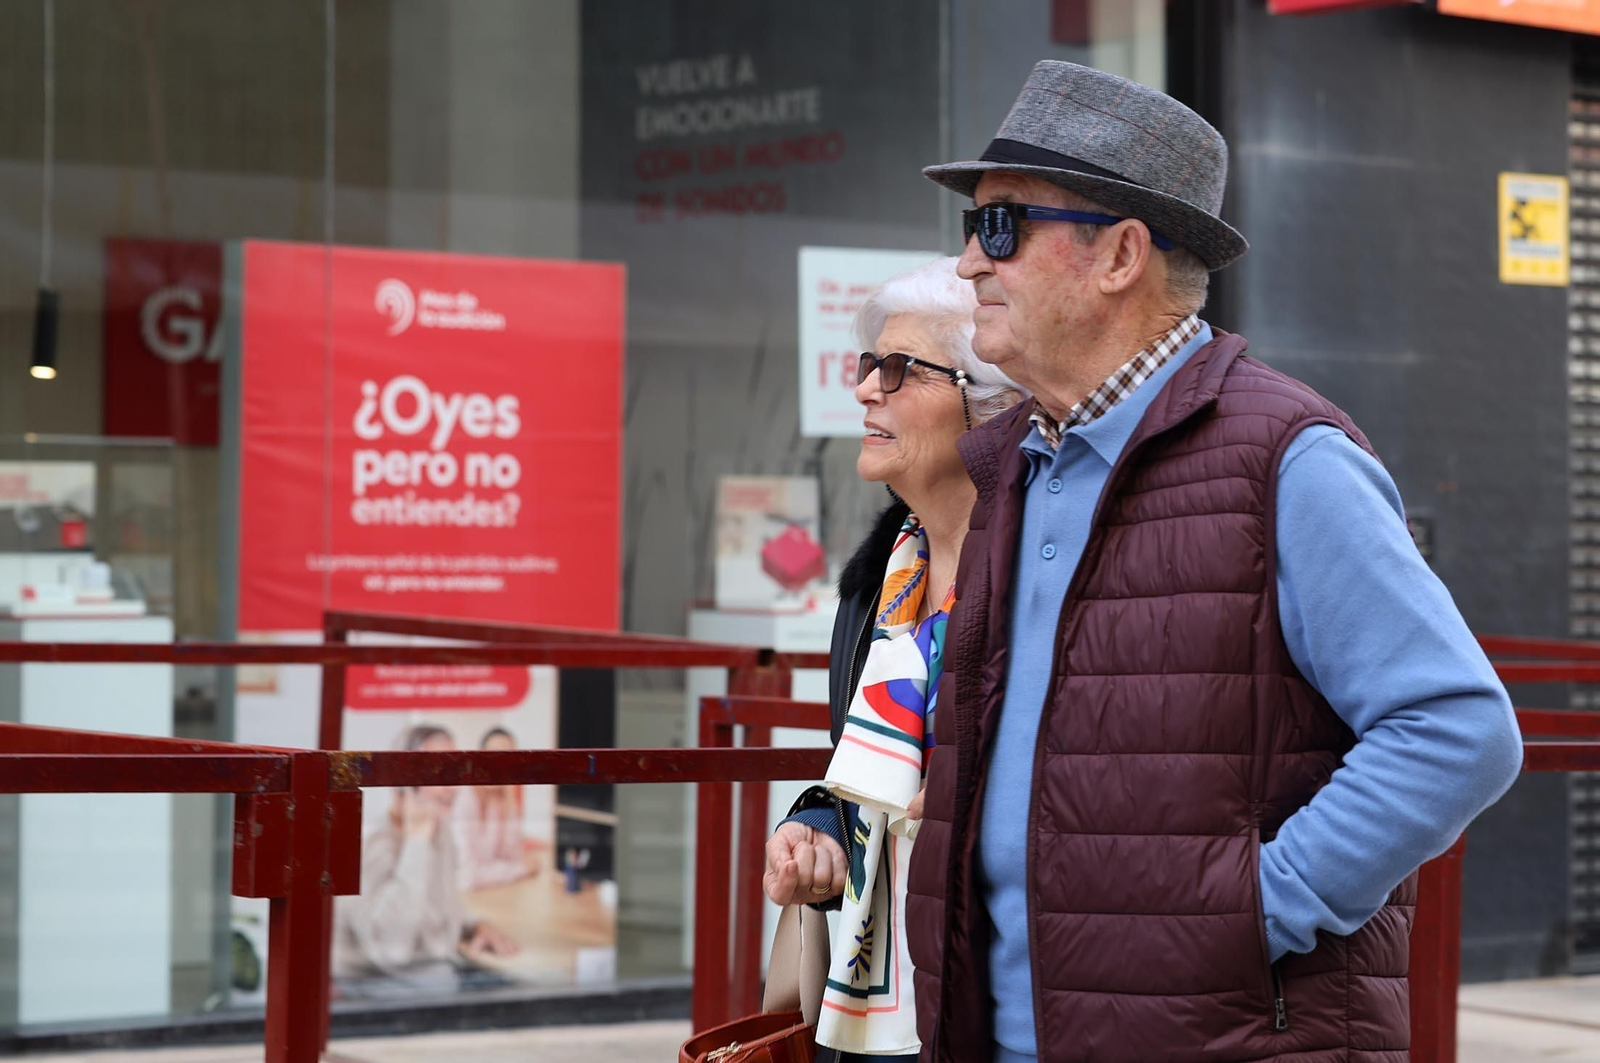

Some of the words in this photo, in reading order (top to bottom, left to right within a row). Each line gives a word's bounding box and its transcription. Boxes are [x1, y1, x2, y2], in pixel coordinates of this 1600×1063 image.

[635, 54, 731, 96] VUELVE
[737, 54, 756, 86] A
[635, 86, 821, 141] EMOCIONARTE
[635, 147, 692, 182] CON
[698, 143, 737, 174] UN
[743, 130, 845, 169] MUNDO
[674, 182, 787, 220] SONIDOS
[353, 375, 521, 450] ¿Oyes
[353, 450, 458, 496] pero
[464, 452, 521, 488] no
[351, 491, 521, 528] entiendes?
